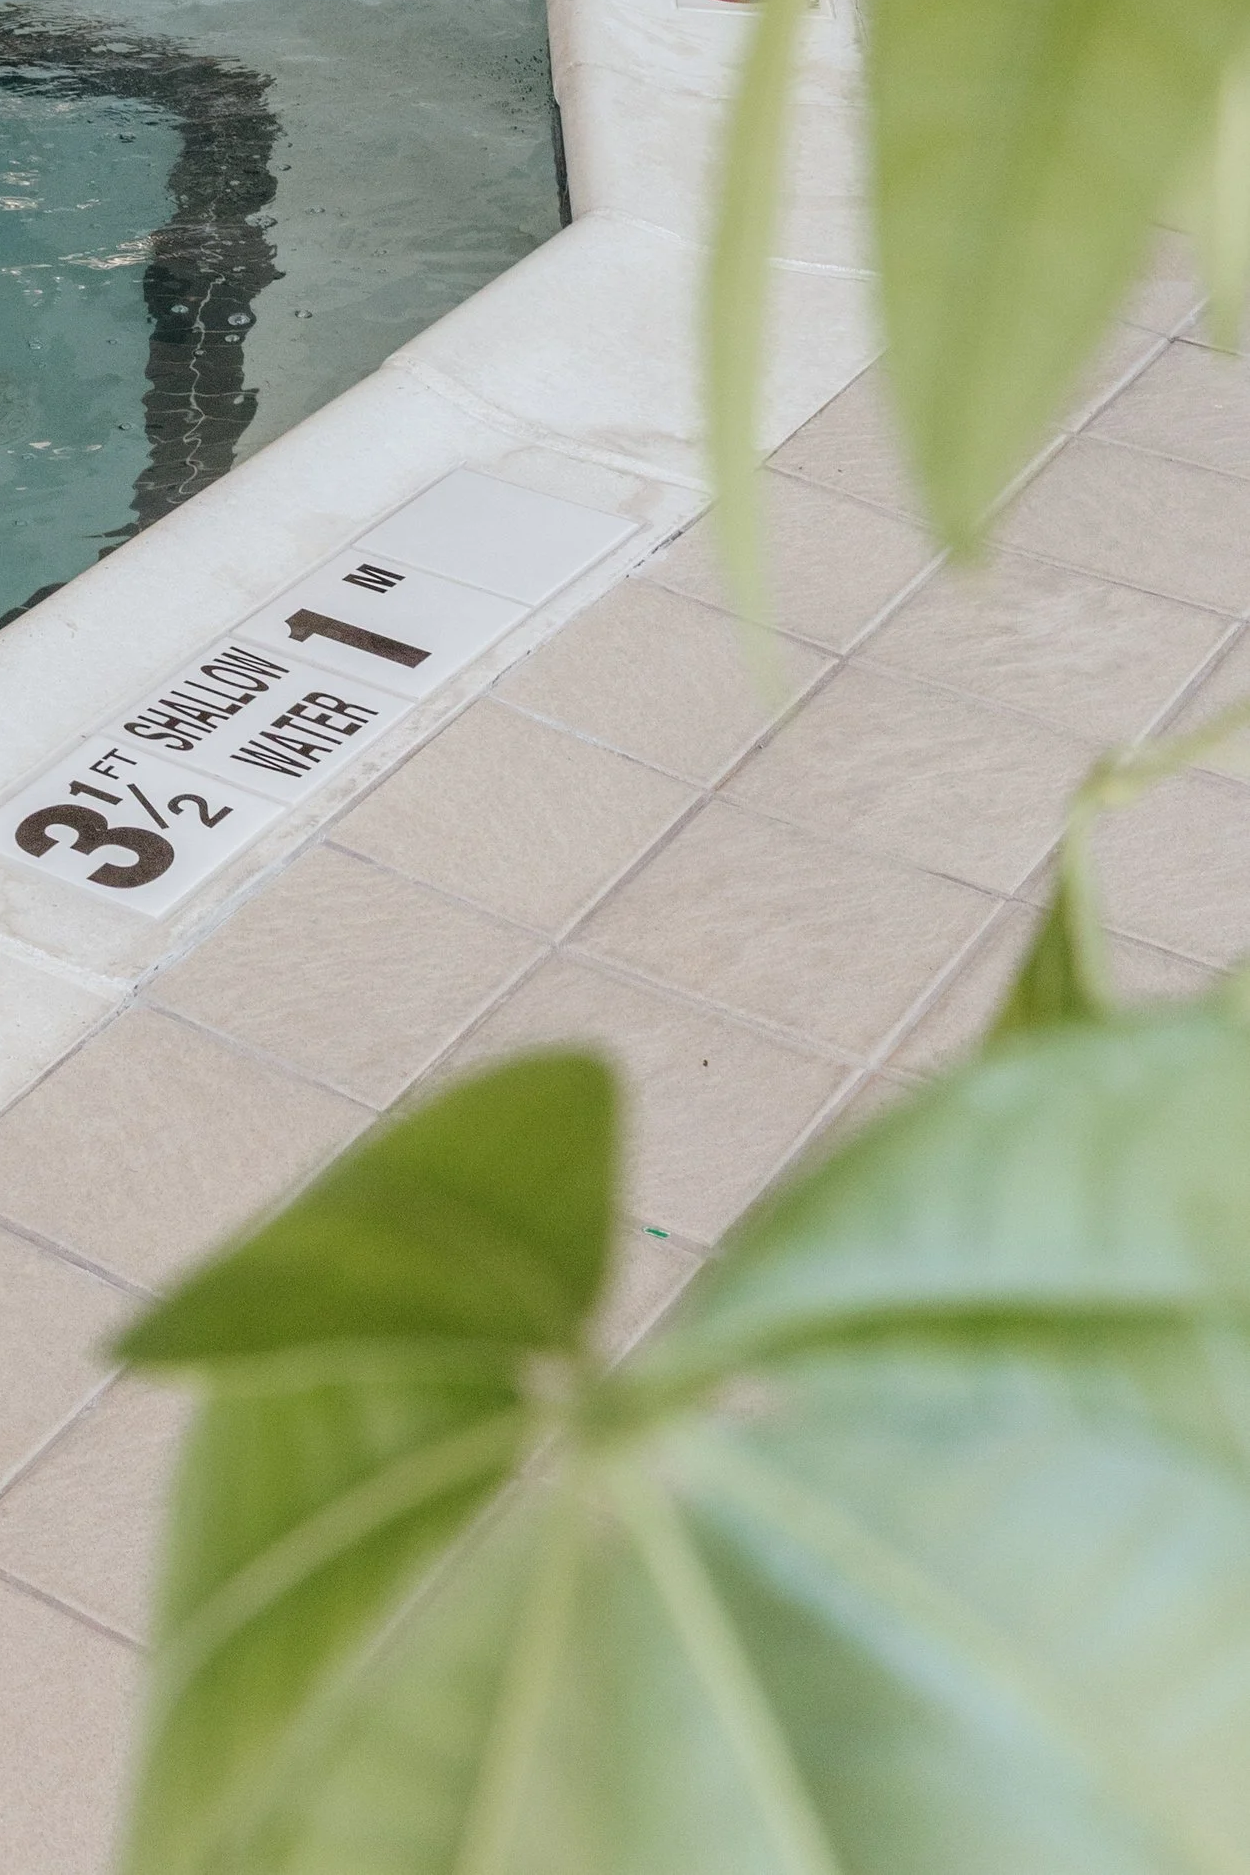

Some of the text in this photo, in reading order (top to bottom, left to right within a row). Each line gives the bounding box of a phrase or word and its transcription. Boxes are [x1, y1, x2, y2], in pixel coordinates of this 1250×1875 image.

[284, 563, 432, 669] 1 M
[123, 646, 290, 752] SHALLOW
[230, 691, 379, 778] WATER
[89, 748, 138, 779] FT
